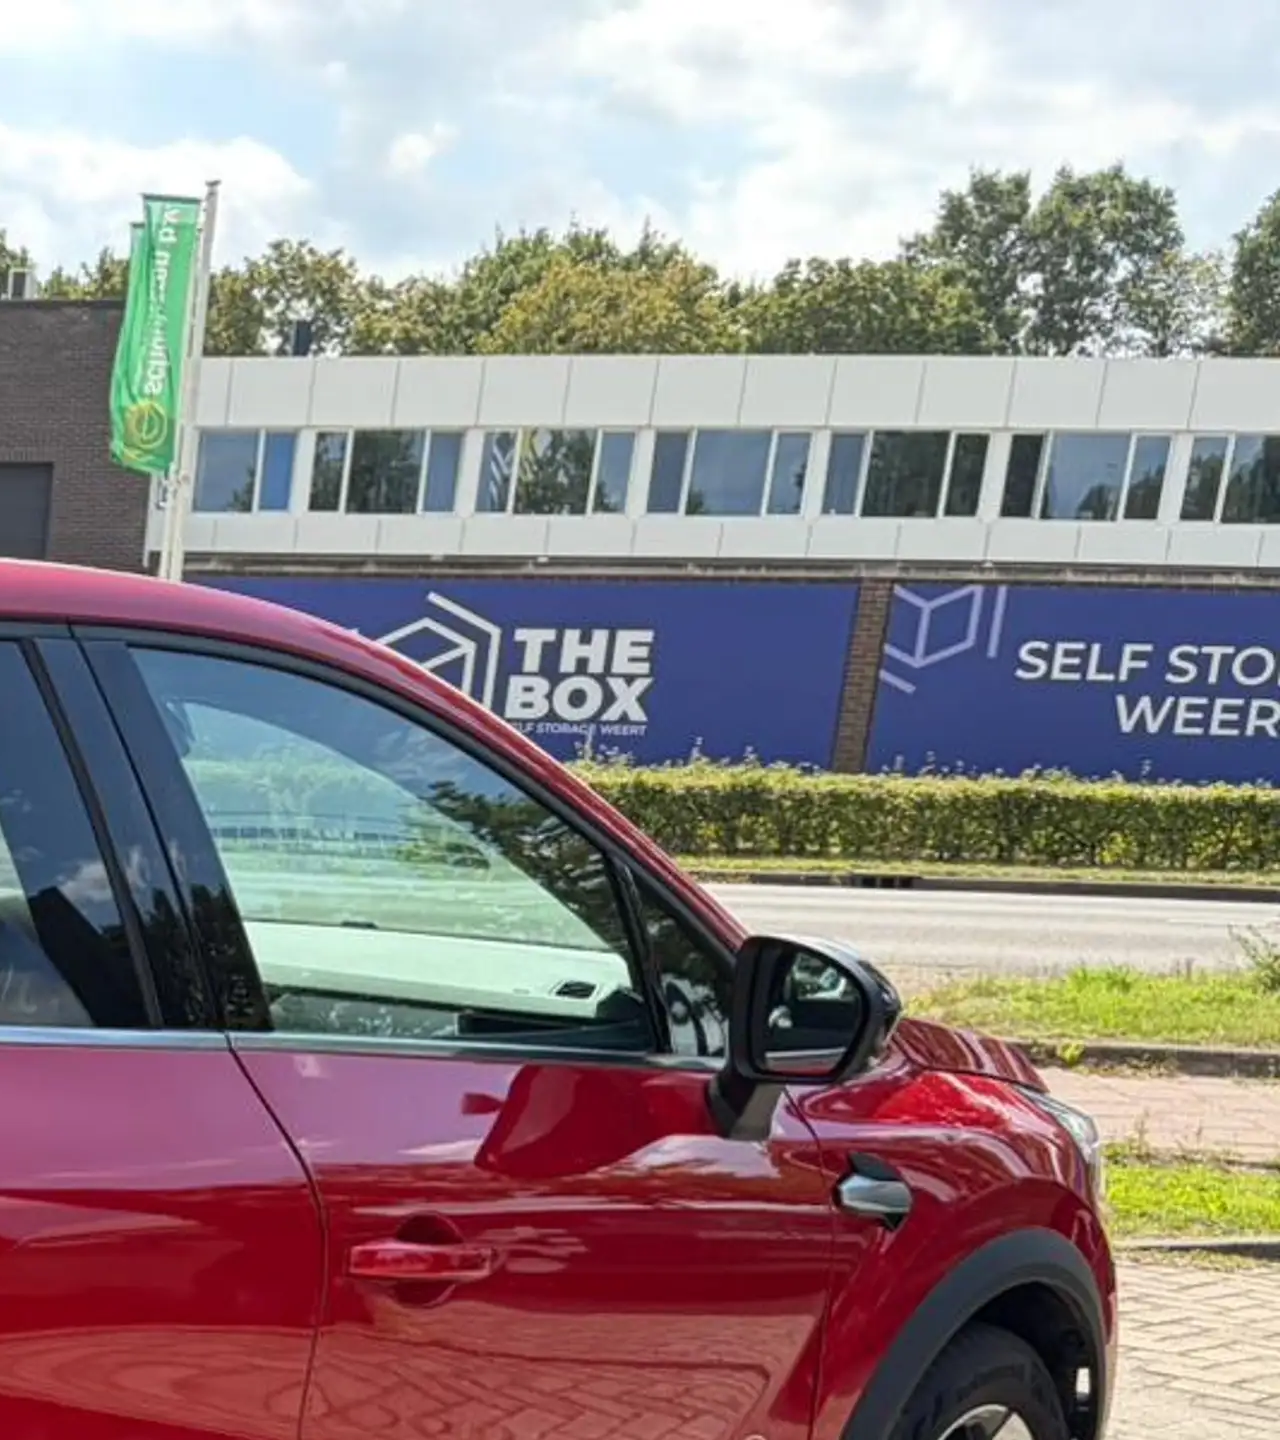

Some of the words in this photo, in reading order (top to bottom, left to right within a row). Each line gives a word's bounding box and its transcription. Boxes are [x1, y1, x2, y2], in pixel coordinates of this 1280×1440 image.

[513, 627, 655, 675] THE
[1014, 640, 1153, 683] SELF
[1164, 644, 1280, 687] STO
[504, 674, 655, 722] BOX
[599, 724, 648, 736] WEERT
